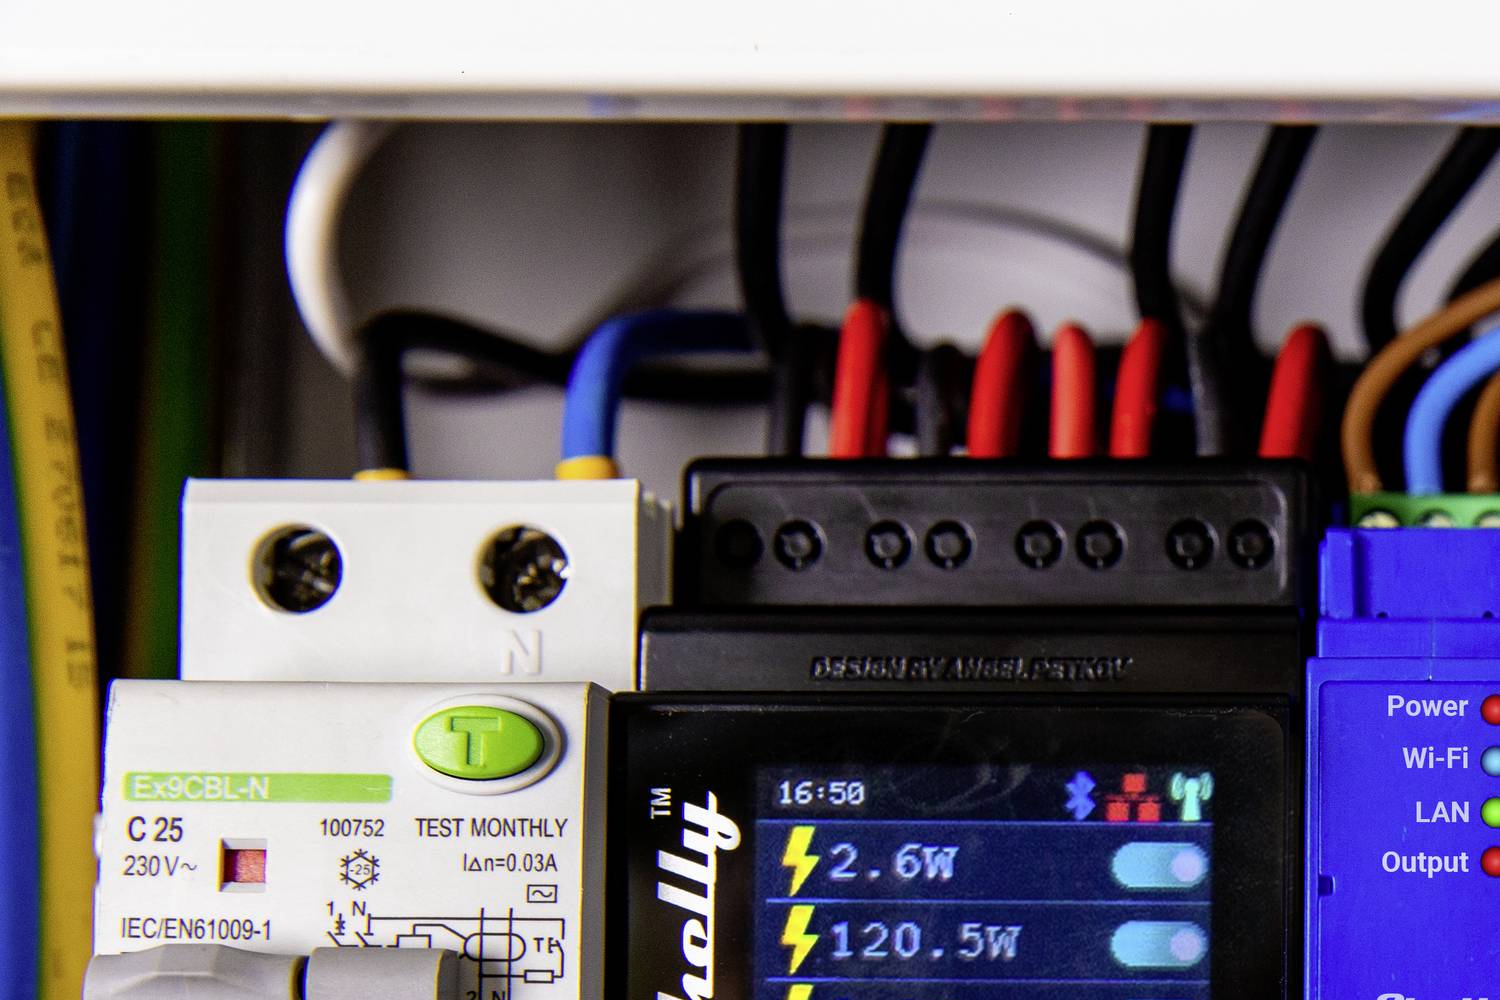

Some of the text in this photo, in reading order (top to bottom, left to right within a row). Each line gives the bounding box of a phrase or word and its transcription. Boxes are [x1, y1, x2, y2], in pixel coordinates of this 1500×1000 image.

[500, 630, 541, 675] N
[811, 656, 906, 680] DESIGN
[1388, 695, 1468, 716] Power
[446, 716, 501, 767] T
[1403, 746, 1468, 768] Wi-Fi
[132, 775, 271, 801] Ex9CBL-N
[781, 781, 864, 805] 16:50
[651, 788, 671, 819] TM
[1416, 801, 1469, 822] LAN
[128, 816, 183, 842] C 25
[321, 819, 384, 837] 100752
[415, 818, 568, 837] TEST MONTHLY
[830, 844, 959, 881] 2.6W
[1382, 851, 1469, 878] Output
[327, 901, 366, 916] 1 N
[122, 918, 270, 940] IEC/EN61009-1
[832, 922, 1021, 960] 120.5W
